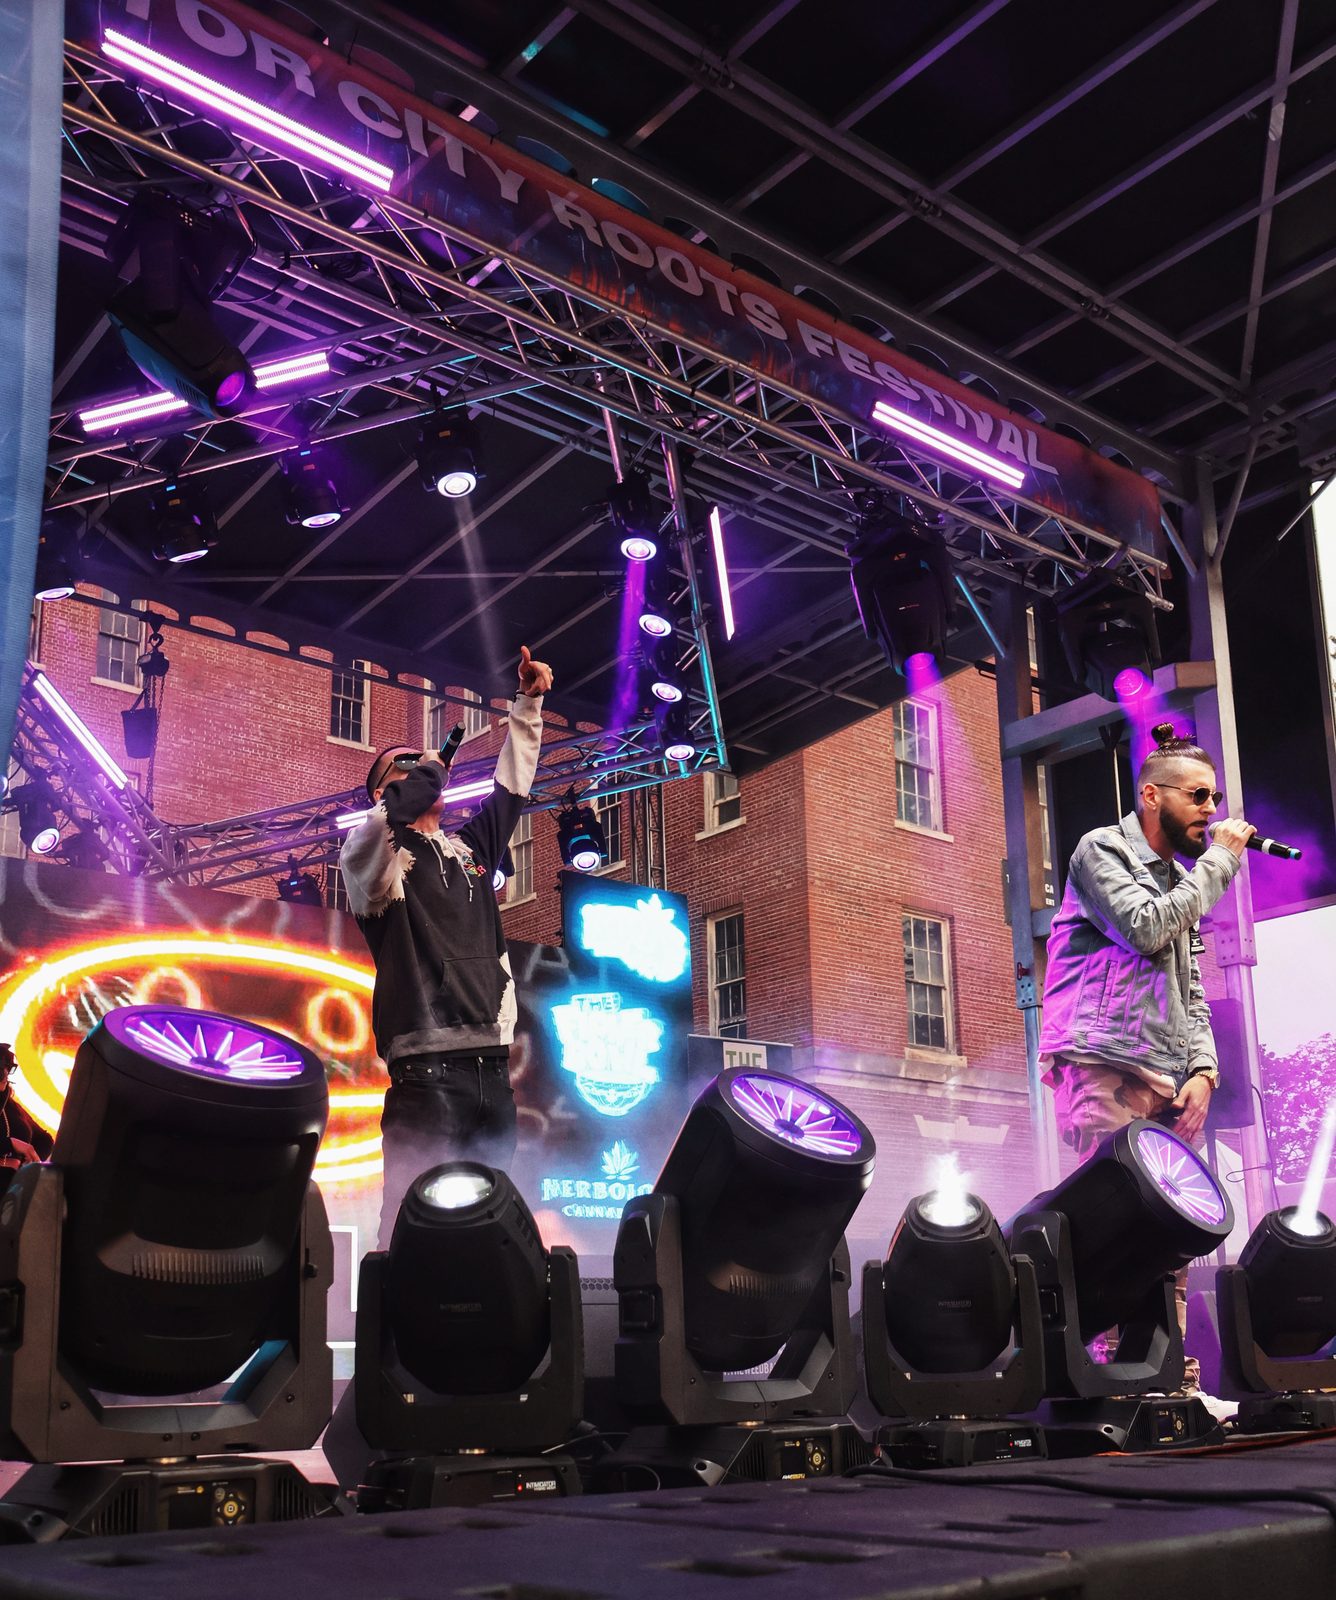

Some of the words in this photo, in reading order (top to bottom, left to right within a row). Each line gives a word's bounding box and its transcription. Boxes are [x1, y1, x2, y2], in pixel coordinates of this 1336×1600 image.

[338, 80, 525, 204] CITY
[547, 189, 788, 341] ROOTS
[797, 319, 1059, 475] FESTIVAL
